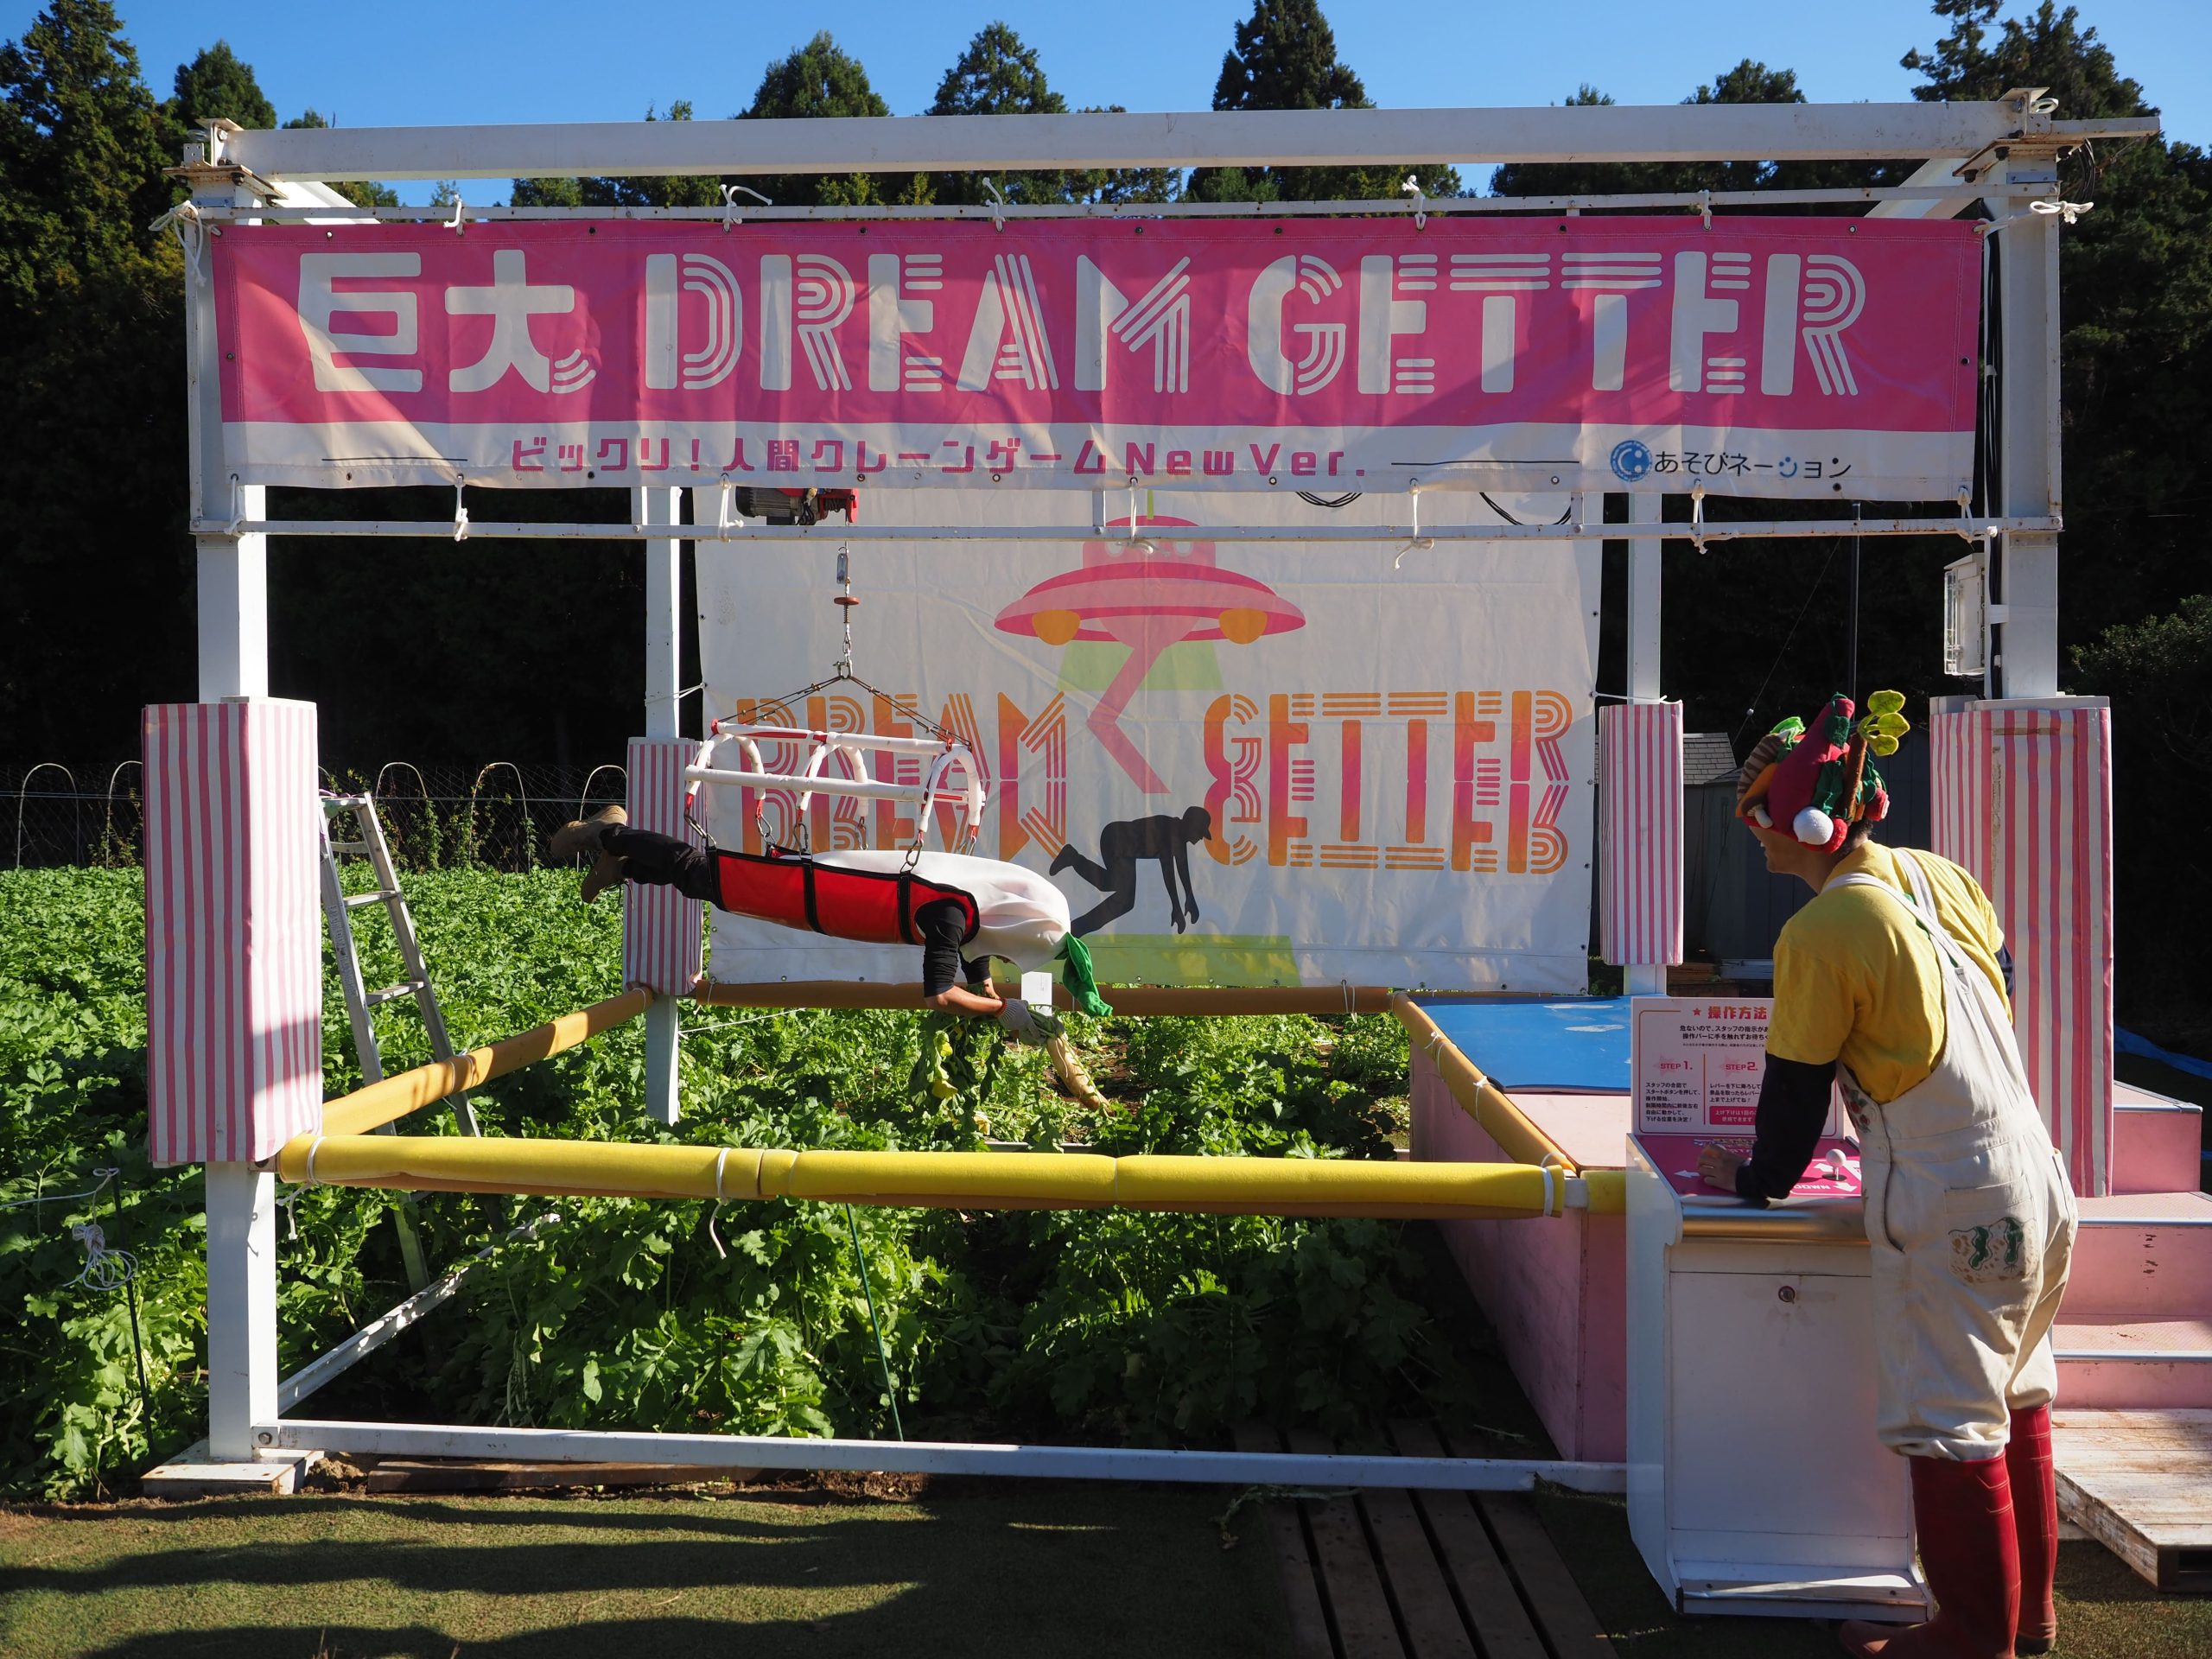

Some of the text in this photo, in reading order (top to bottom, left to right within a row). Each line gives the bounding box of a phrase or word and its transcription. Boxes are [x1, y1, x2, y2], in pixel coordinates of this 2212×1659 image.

[298, 249, 1866, 397] 巨大 DREAM GETTER
[1707, 1005, 1768, 1020] 操作方法
